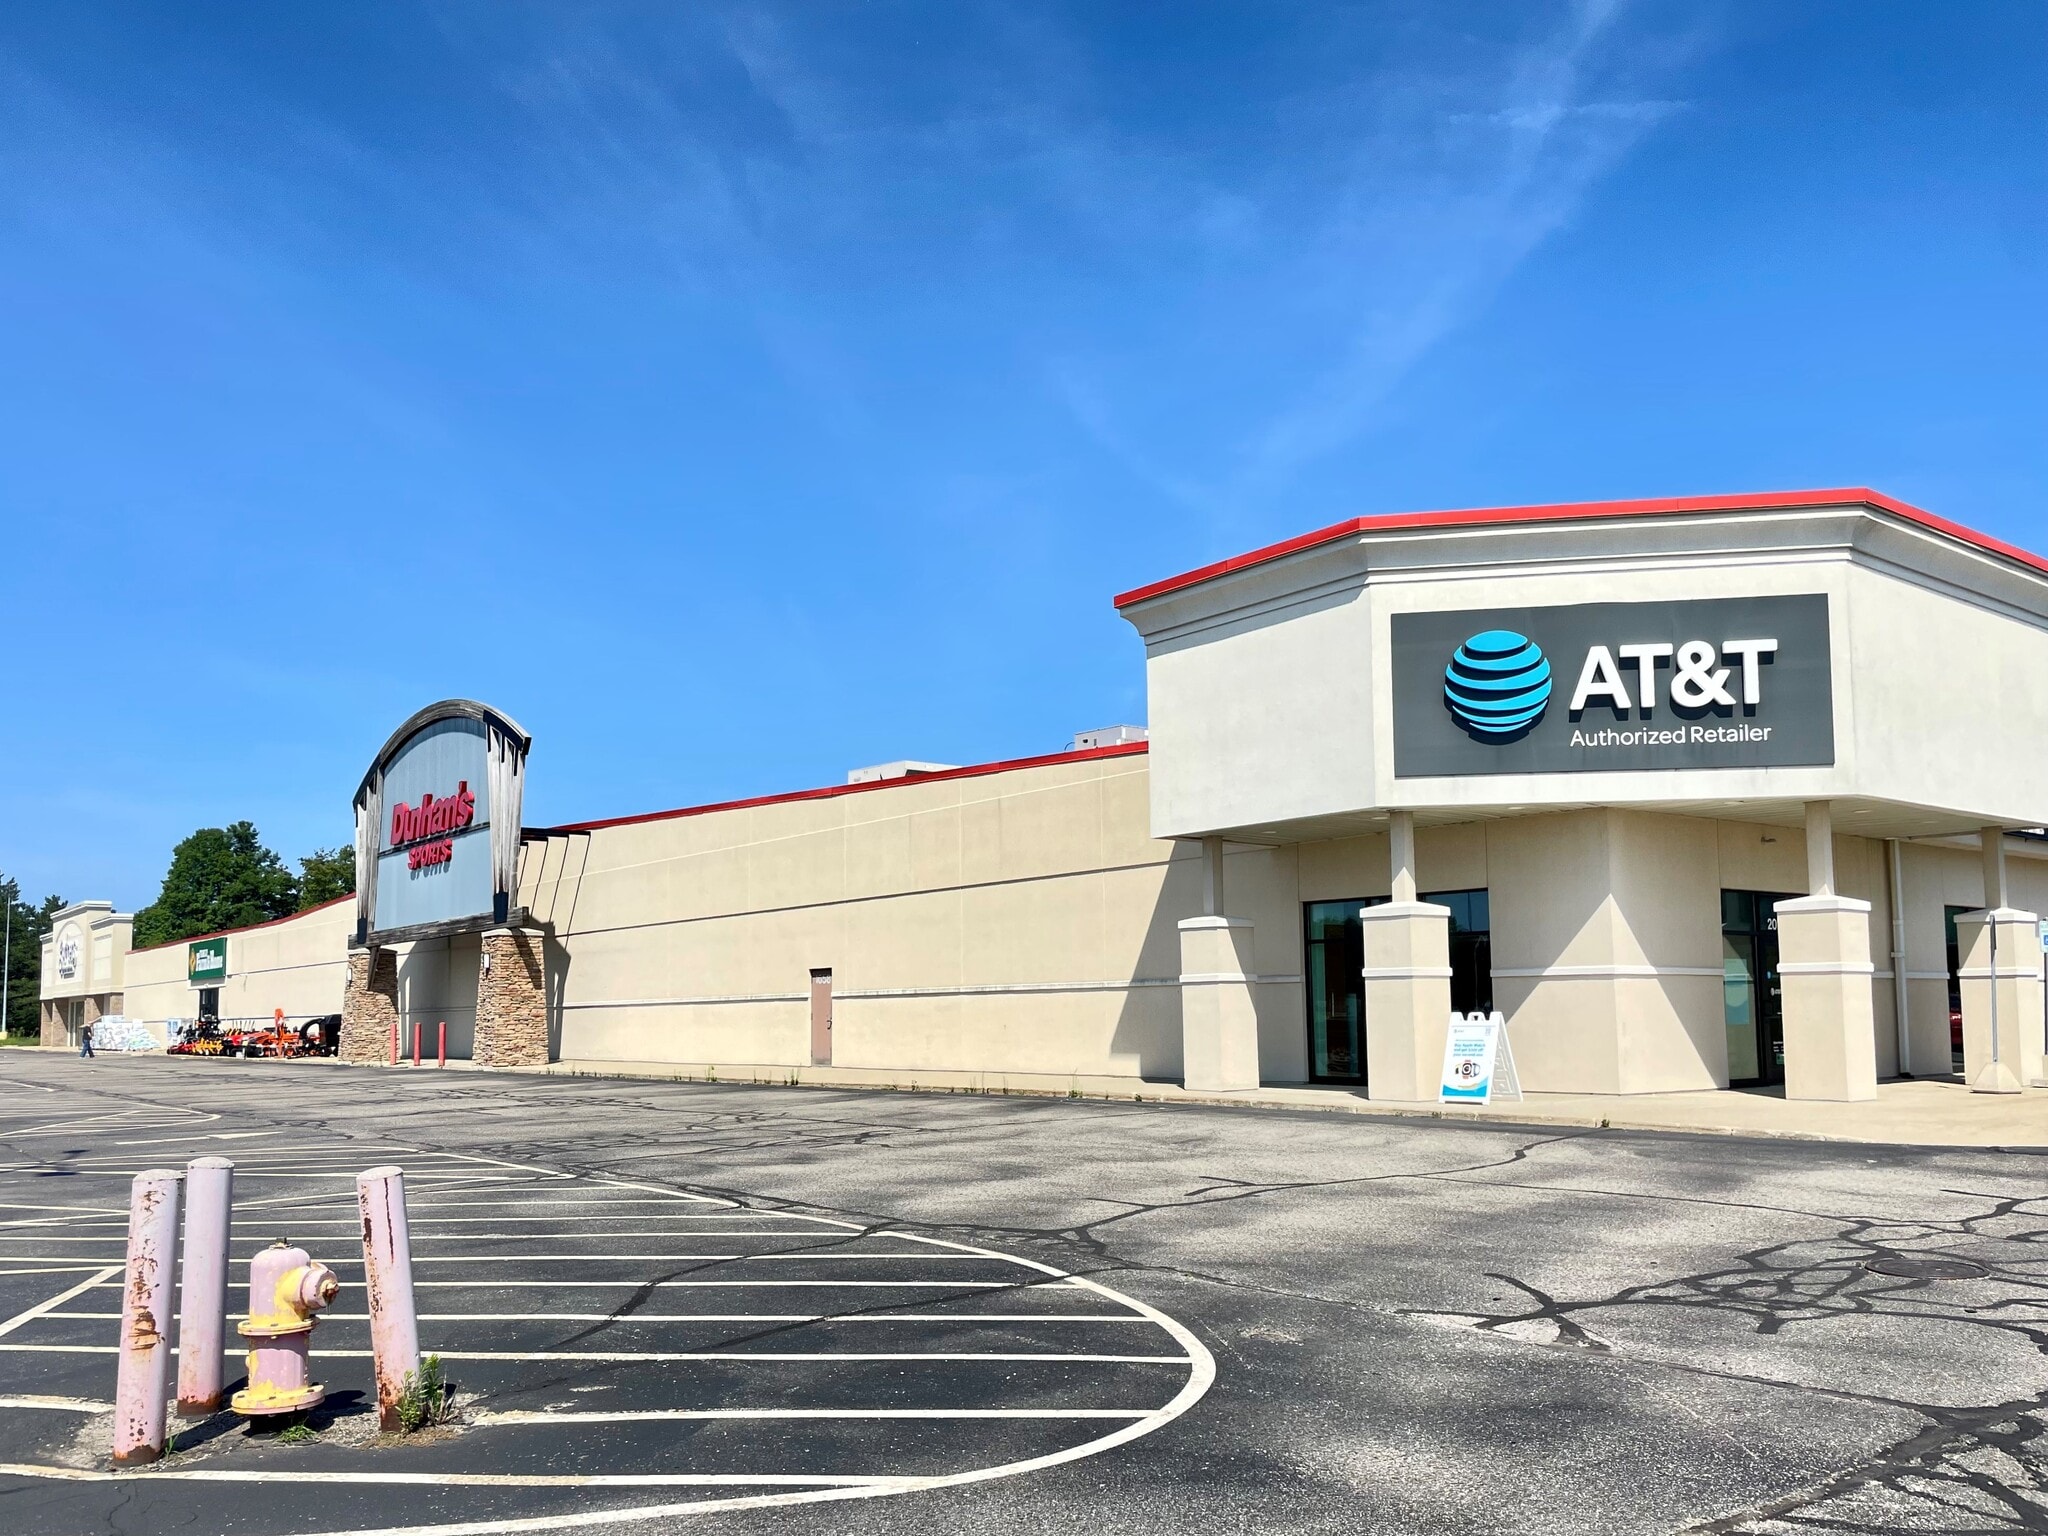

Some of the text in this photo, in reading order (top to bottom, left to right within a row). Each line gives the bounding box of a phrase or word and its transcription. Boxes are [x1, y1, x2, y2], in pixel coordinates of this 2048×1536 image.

[1569, 638, 1779, 711] AT&T
[1570, 723, 1773, 747] Authorized Retailer
[390, 780, 475, 846] Dunham's
[407, 838, 453, 870] SPORTS
